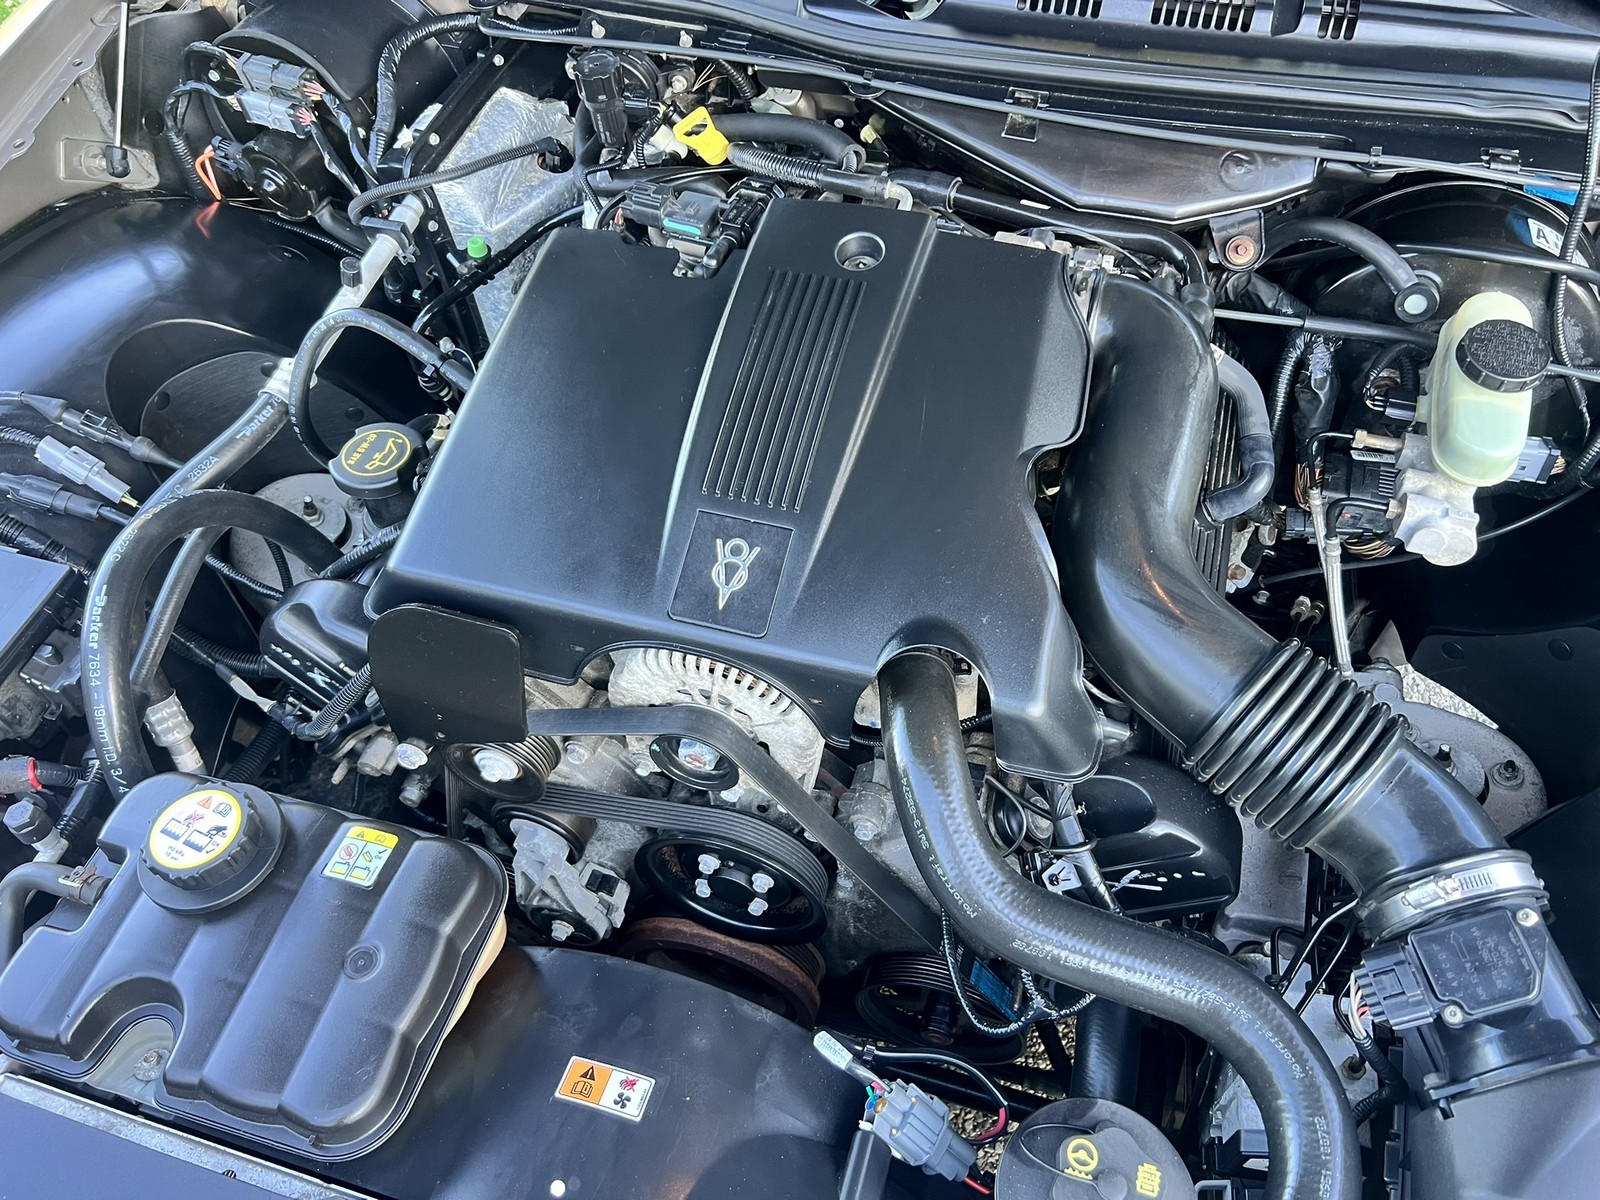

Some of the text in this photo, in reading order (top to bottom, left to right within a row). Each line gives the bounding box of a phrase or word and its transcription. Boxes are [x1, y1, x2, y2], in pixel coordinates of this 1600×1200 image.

[236, 405, 274, 437] Parker
[187, 455, 220, 482] 2632A
[89, 584, 108, 650] Parker
[89, 653, 102, 687] 7634
[93, 704, 109, 742] 19mm
[927, 853, 978, 919] Motorcraft
[1254, 1022, 1306, 1080] Motorcraft
